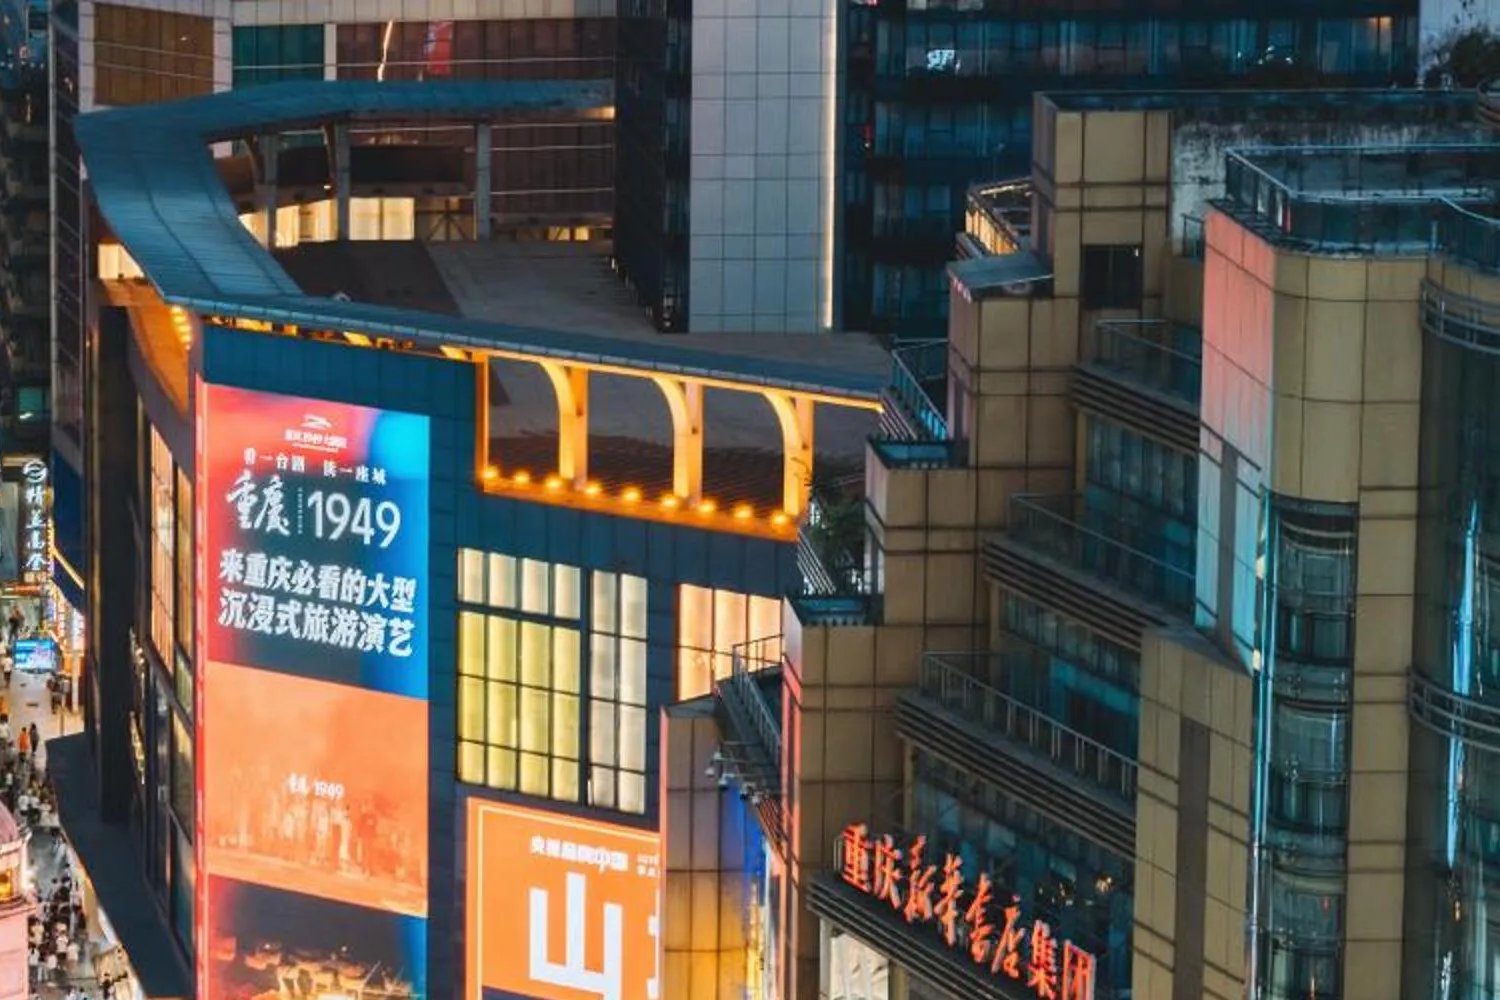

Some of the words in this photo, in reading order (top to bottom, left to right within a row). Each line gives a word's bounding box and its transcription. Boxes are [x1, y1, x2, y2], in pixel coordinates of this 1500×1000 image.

[225, 468, 291, 537] 重庆
[306, 489, 401, 548] 1949
[219, 548, 417, 614] 来重庆必看的大型
[218, 586, 416, 658] 沉浸式旅游演艺
